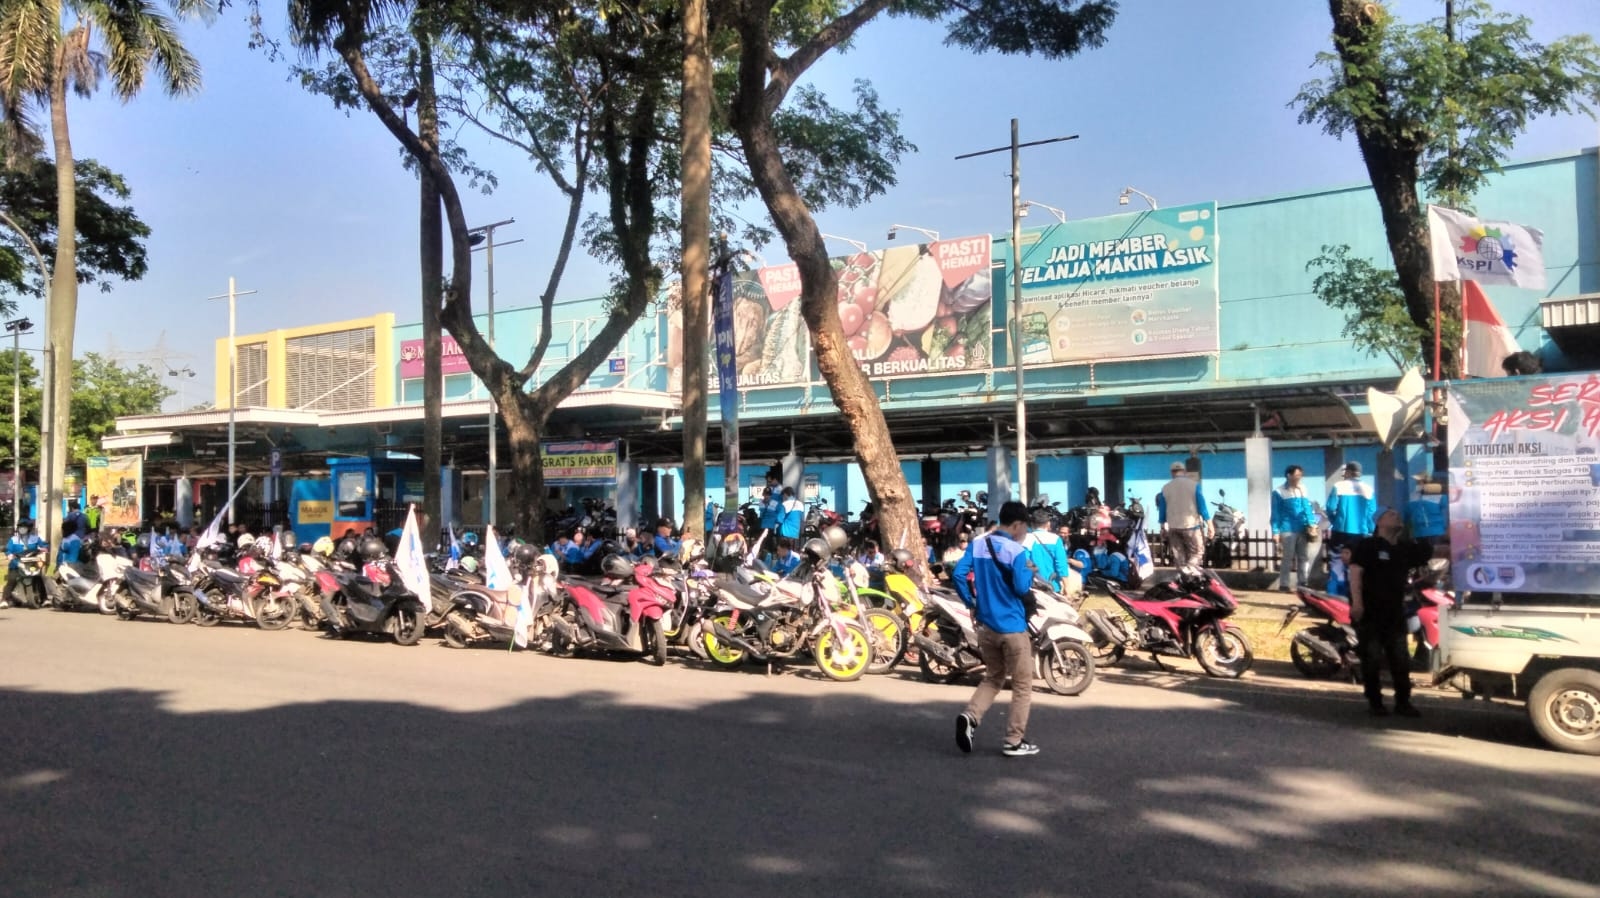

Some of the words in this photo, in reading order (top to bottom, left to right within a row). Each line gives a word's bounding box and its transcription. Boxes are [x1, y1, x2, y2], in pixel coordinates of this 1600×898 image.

[939, 238, 986, 258] PASTI
[1046, 244, 1085, 264] JADI
[1089, 233, 1168, 257] MEMBER
[941, 254, 985, 270] HEMAT
[1095, 250, 1158, 275] MAKIN
[1162, 246, 1212, 270] ASIK
[1455, 255, 1493, 271] KSPI
[1054, 291, 1081, 300] aplikasi
[1109, 285, 1137, 294] nikmati
[1138, 282, 1168, 292] voucher
[1170, 279, 1199, 289] belanja
[1065, 298, 1089, 308] benefit
[1090, 296, 1120, 305] member
[873, 355, 966, 375] BERKUALITAS
[1482, 406, 1569, 444] AKSI
[1463, 443, 1515, 456] TUNTUTAN
[1518, 442, 1542, 454] AKSI
[543, 456, 576, 467] GRATIS
[578, 455, 614, 466] PARKIR
